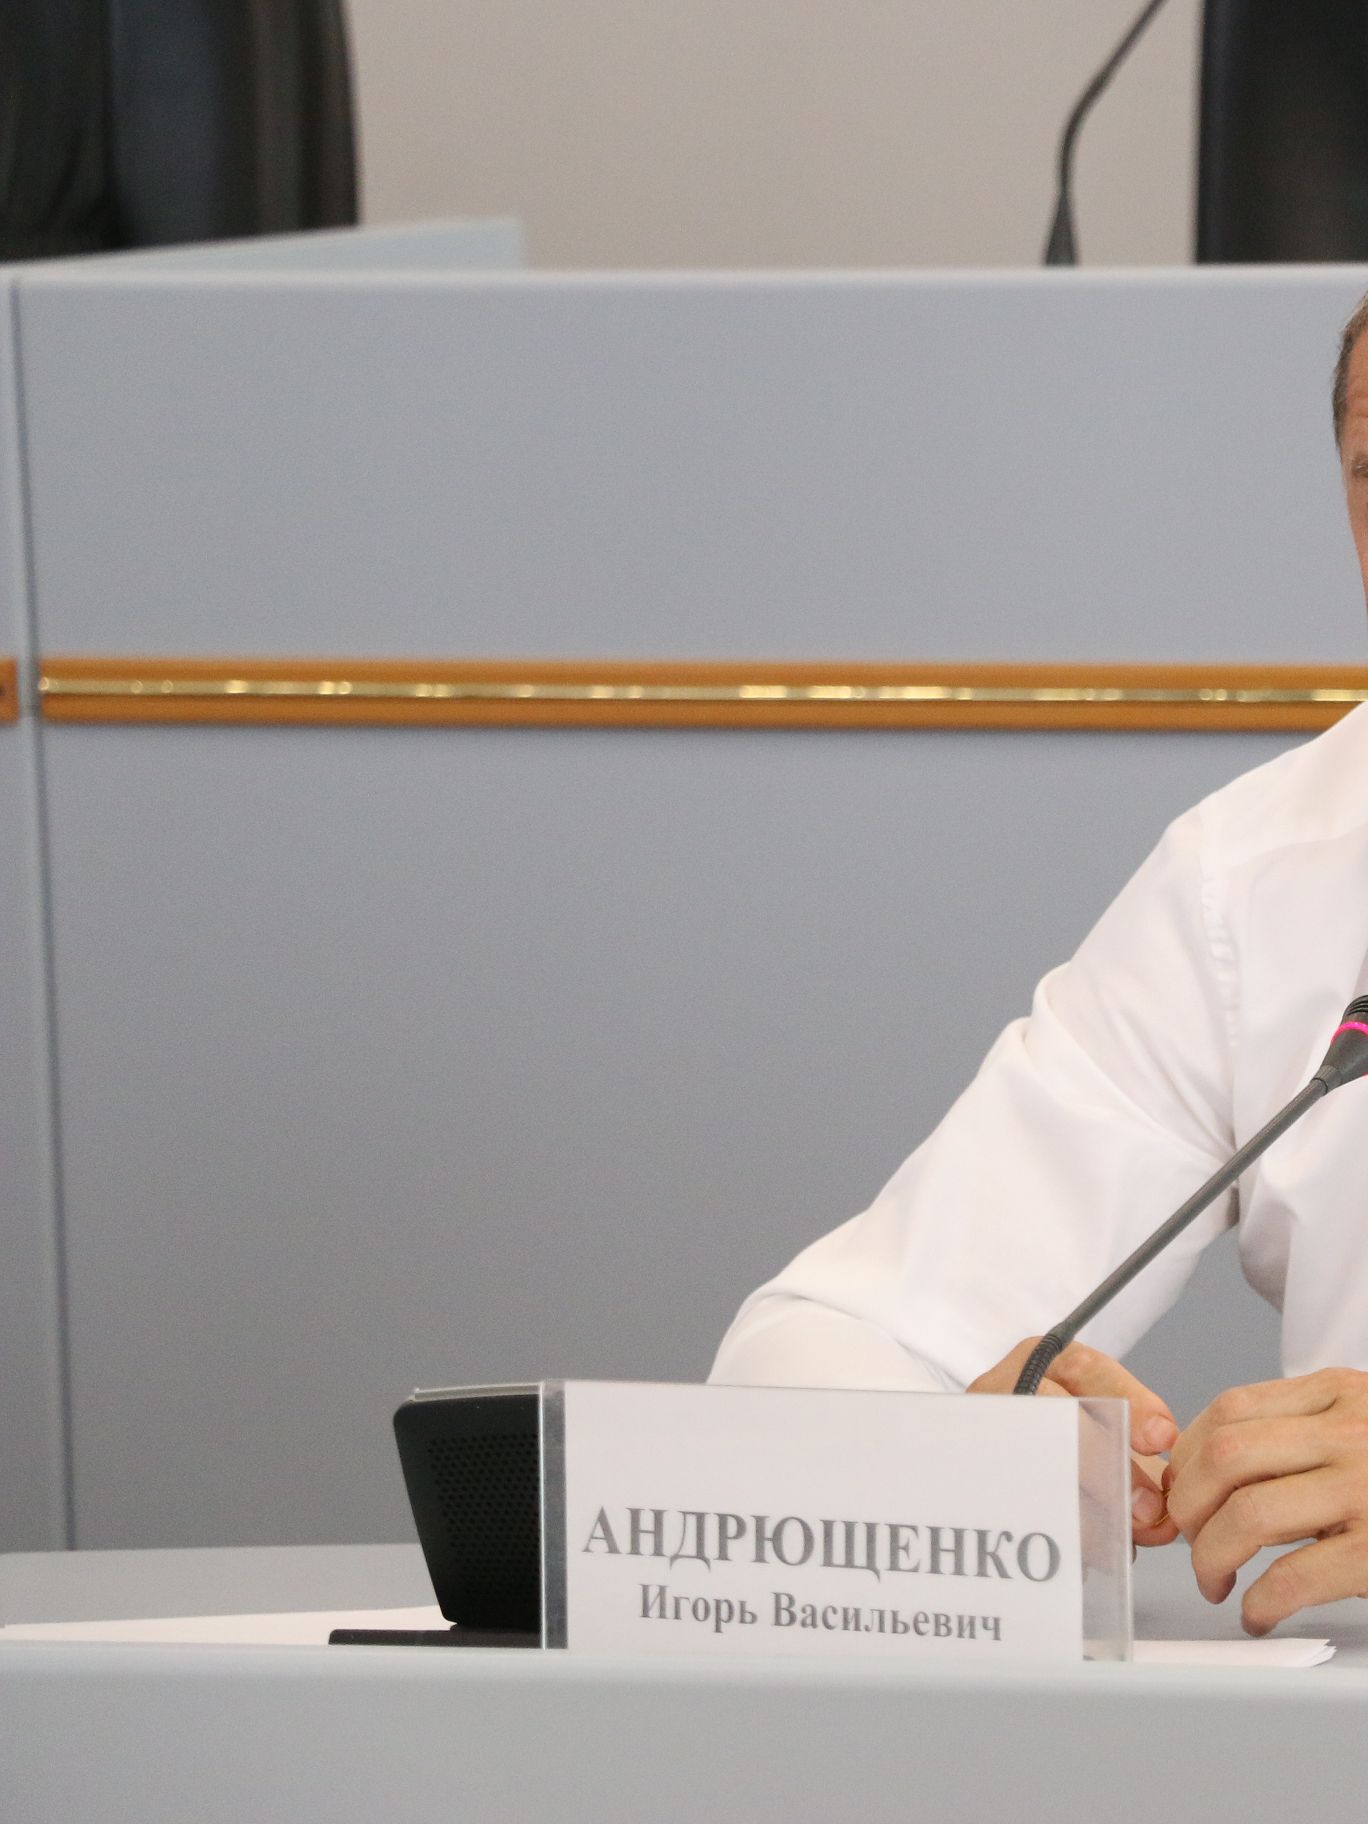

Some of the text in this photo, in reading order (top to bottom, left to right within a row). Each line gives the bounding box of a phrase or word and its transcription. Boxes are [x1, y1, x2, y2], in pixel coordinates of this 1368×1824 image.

[582, 1505, 1062, 1583] АНДРЮЩЕНКО
[640, 1583, 1004, 1641] Игорь Васильевич
